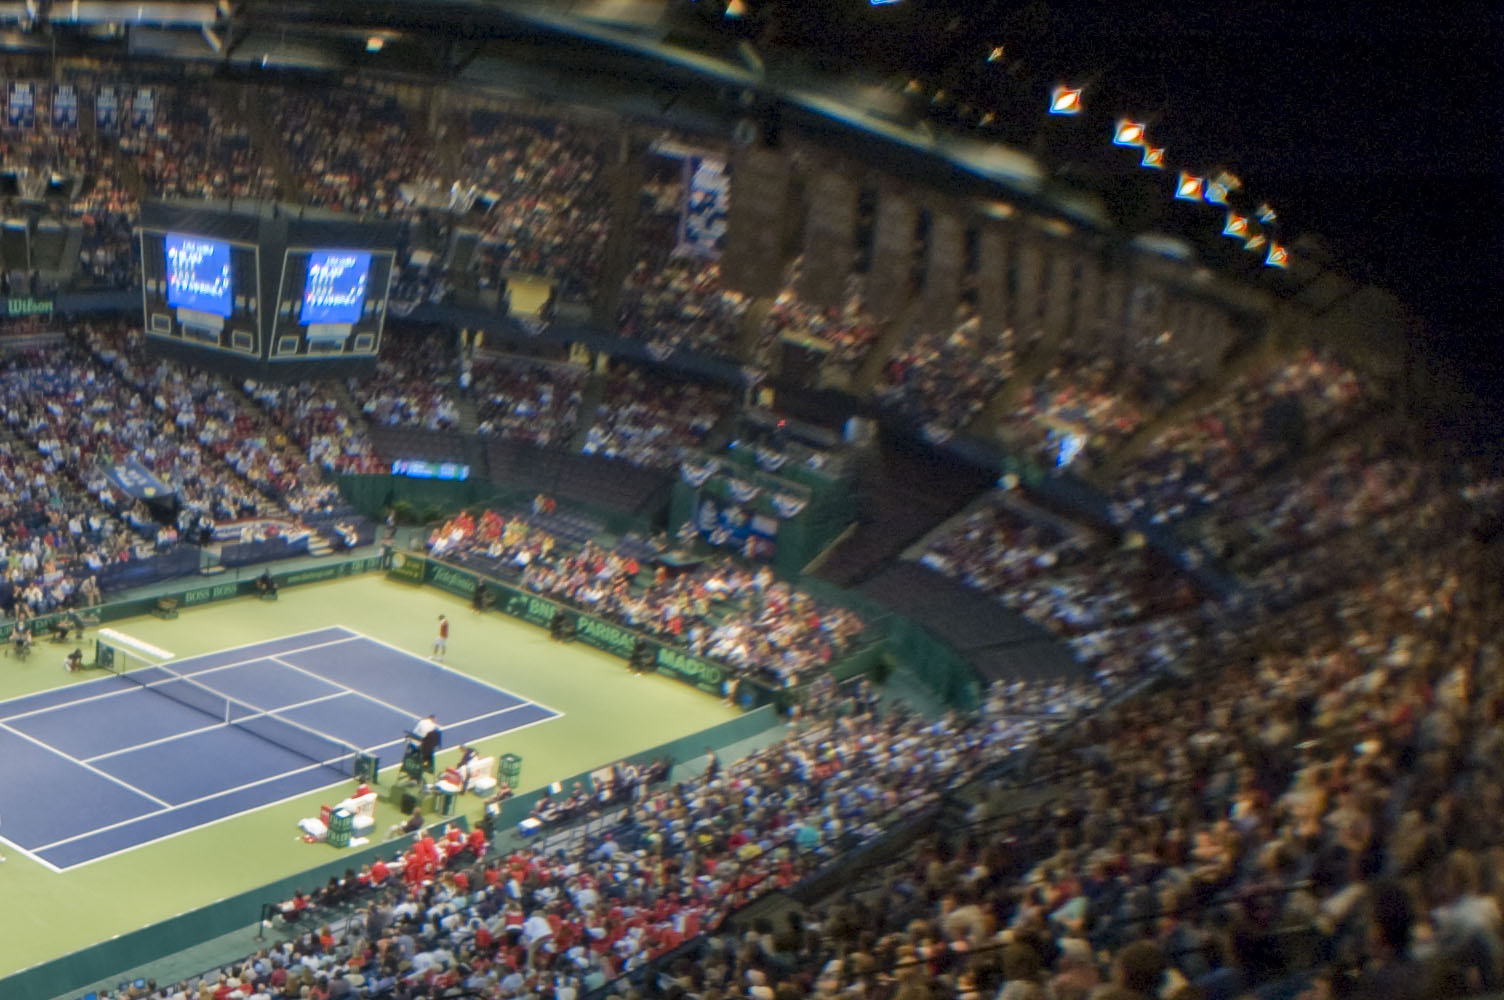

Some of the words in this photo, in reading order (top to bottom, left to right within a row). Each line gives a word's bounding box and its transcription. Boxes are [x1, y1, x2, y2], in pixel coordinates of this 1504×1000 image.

[185, 591, 209, 602] BOSS
[529, 599, 557, 620] BNP
[577, 616, 637, 652] PARIBAS
[658, 647, 721, 684] MADRID
